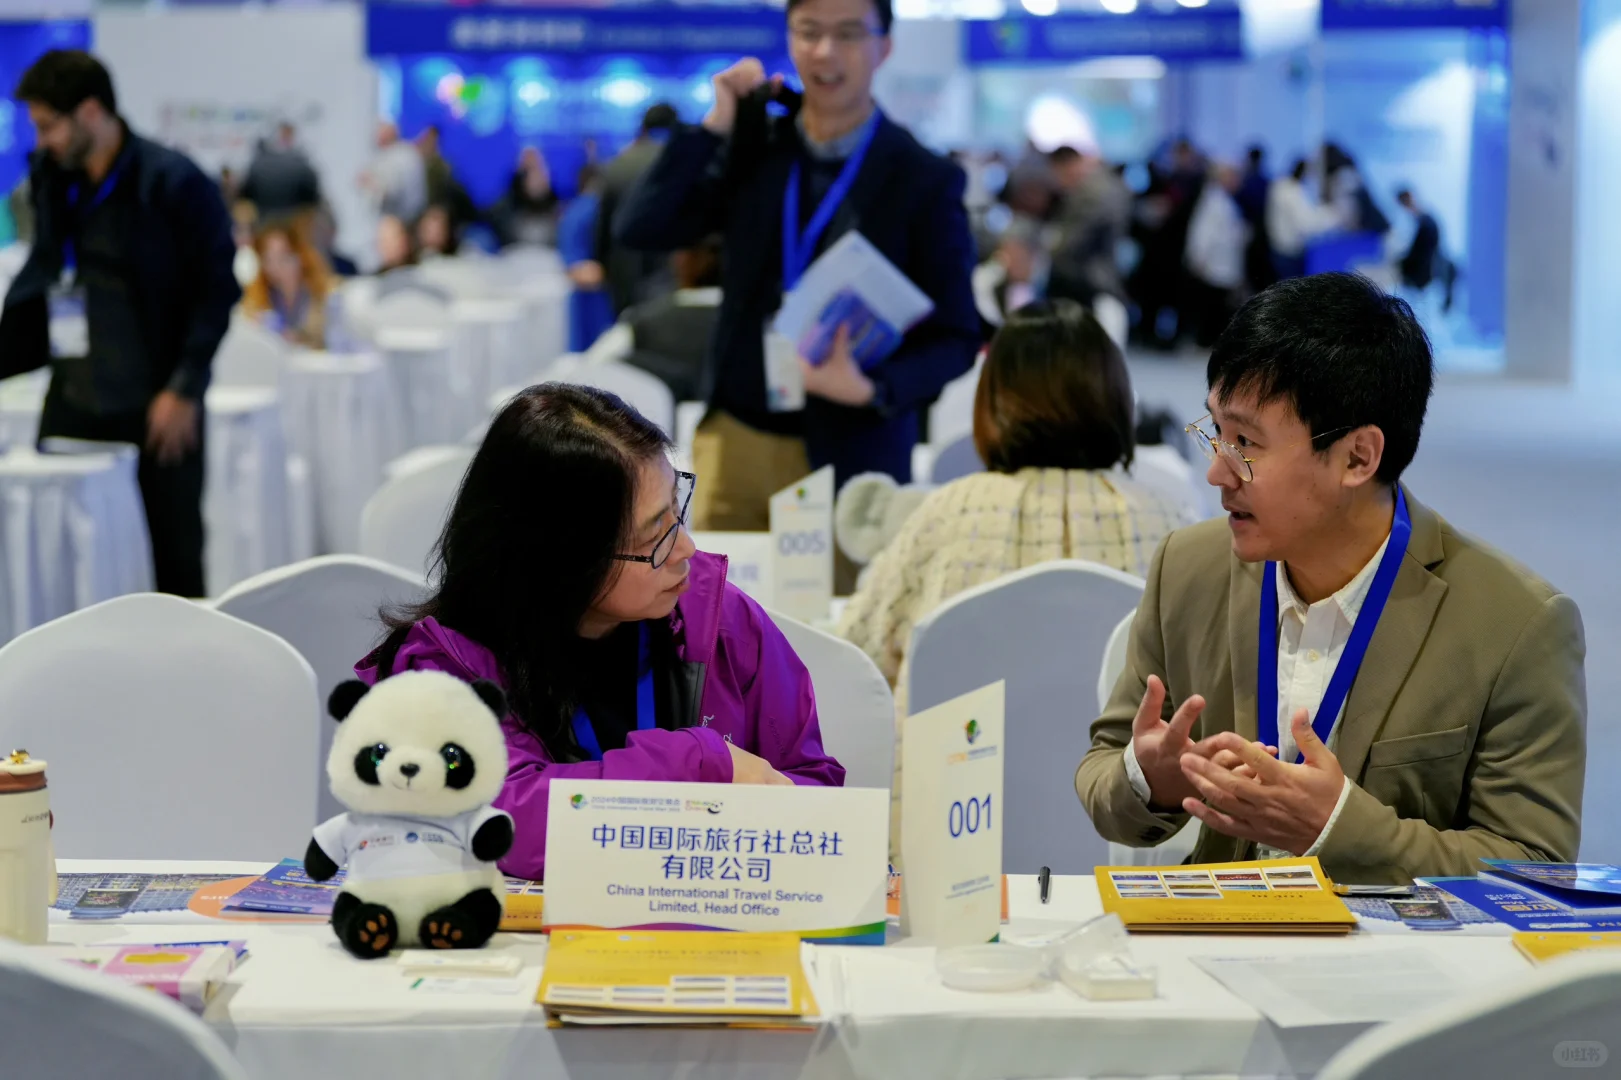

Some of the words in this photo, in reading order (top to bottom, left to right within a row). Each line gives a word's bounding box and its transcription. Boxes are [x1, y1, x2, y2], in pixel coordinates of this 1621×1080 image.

[949, 793, 992, 838] 001
[592, 823, 843, 856] 中国国际旅行社总社
[661, 855, 771, 882] 有限公司
[606, 884, 645, 897] China
[648, 886, 729, 900] International
[733, 888, 772, 900] Travel
[775, 890, 823, 903] Service
[649, 900, 701, 914] Limited,
[704, 902, 738, 915] Head
[741, 903, 780, 916] Office
